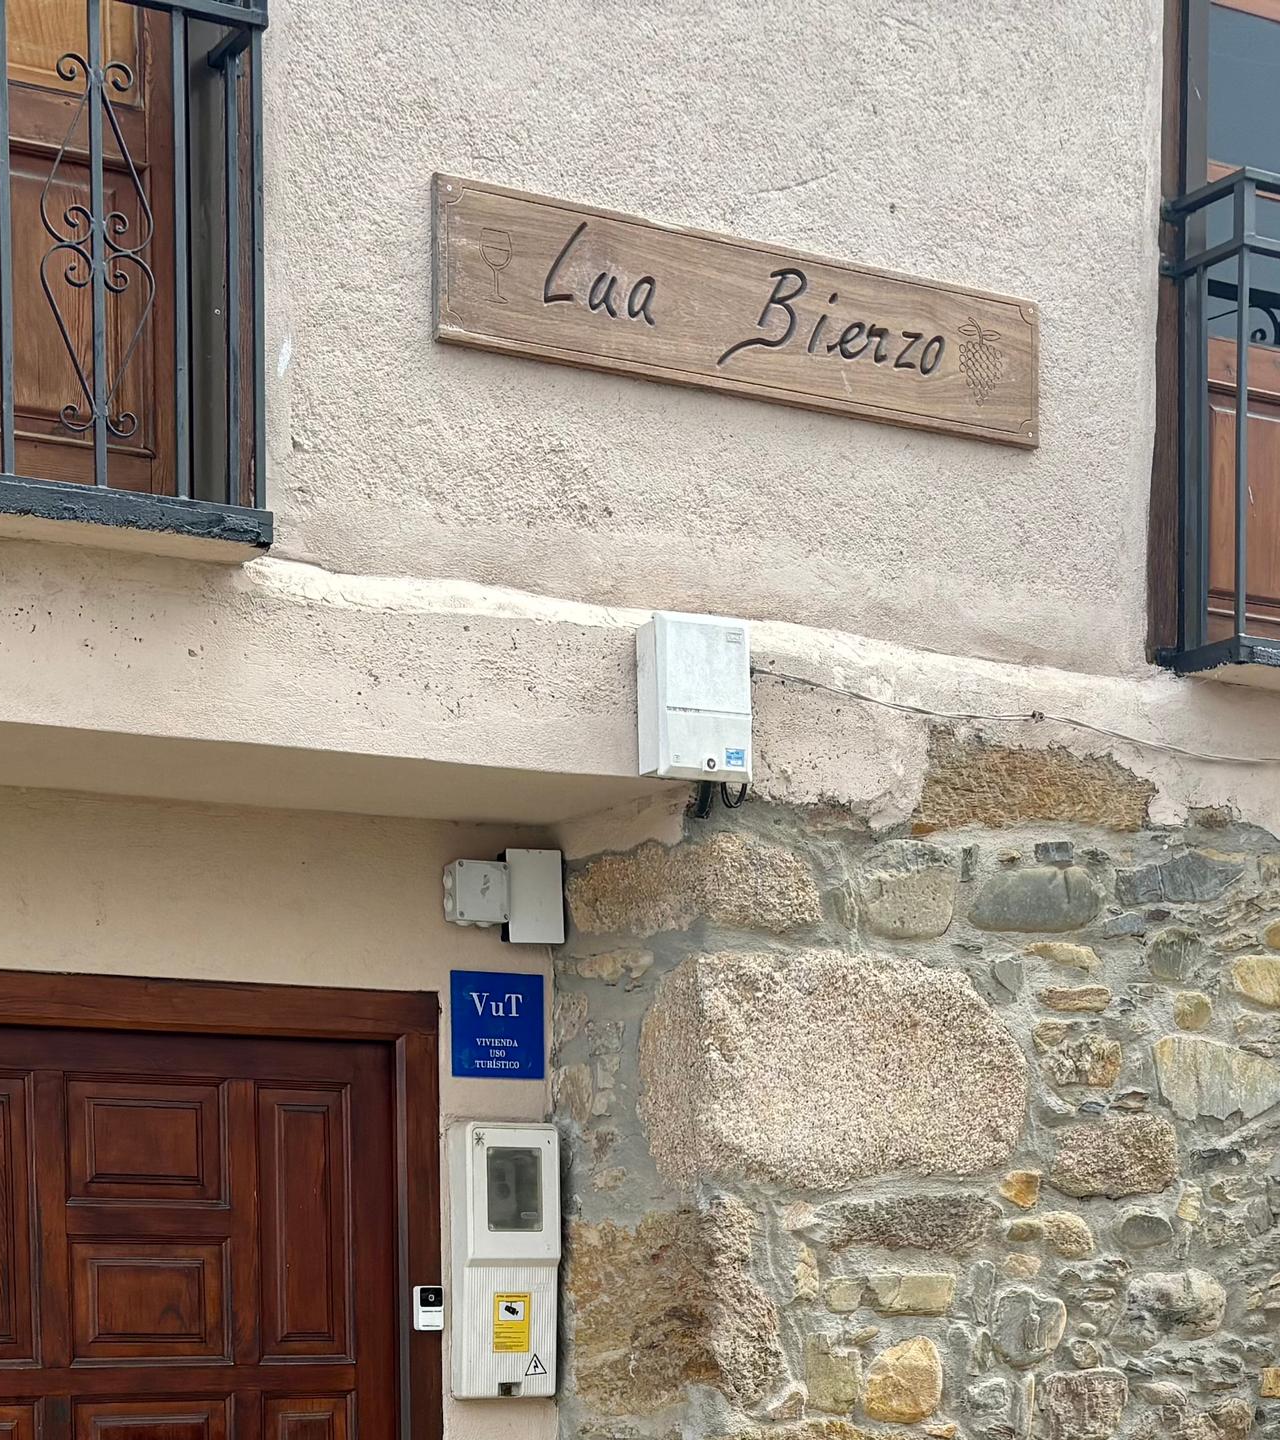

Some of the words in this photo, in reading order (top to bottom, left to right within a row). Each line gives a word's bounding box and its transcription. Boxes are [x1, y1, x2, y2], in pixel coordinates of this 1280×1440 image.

[543, 222, 656, 326] Lua
[718, 267, 945, 376] Bierzo
[469, 992, 523, 1017] VuT
[476, 1038, 518, 1047] VIVIENDA
[489, 1049, 506, 1058] USO
[475, 1058, 520, 1069] TURÍSTICO
